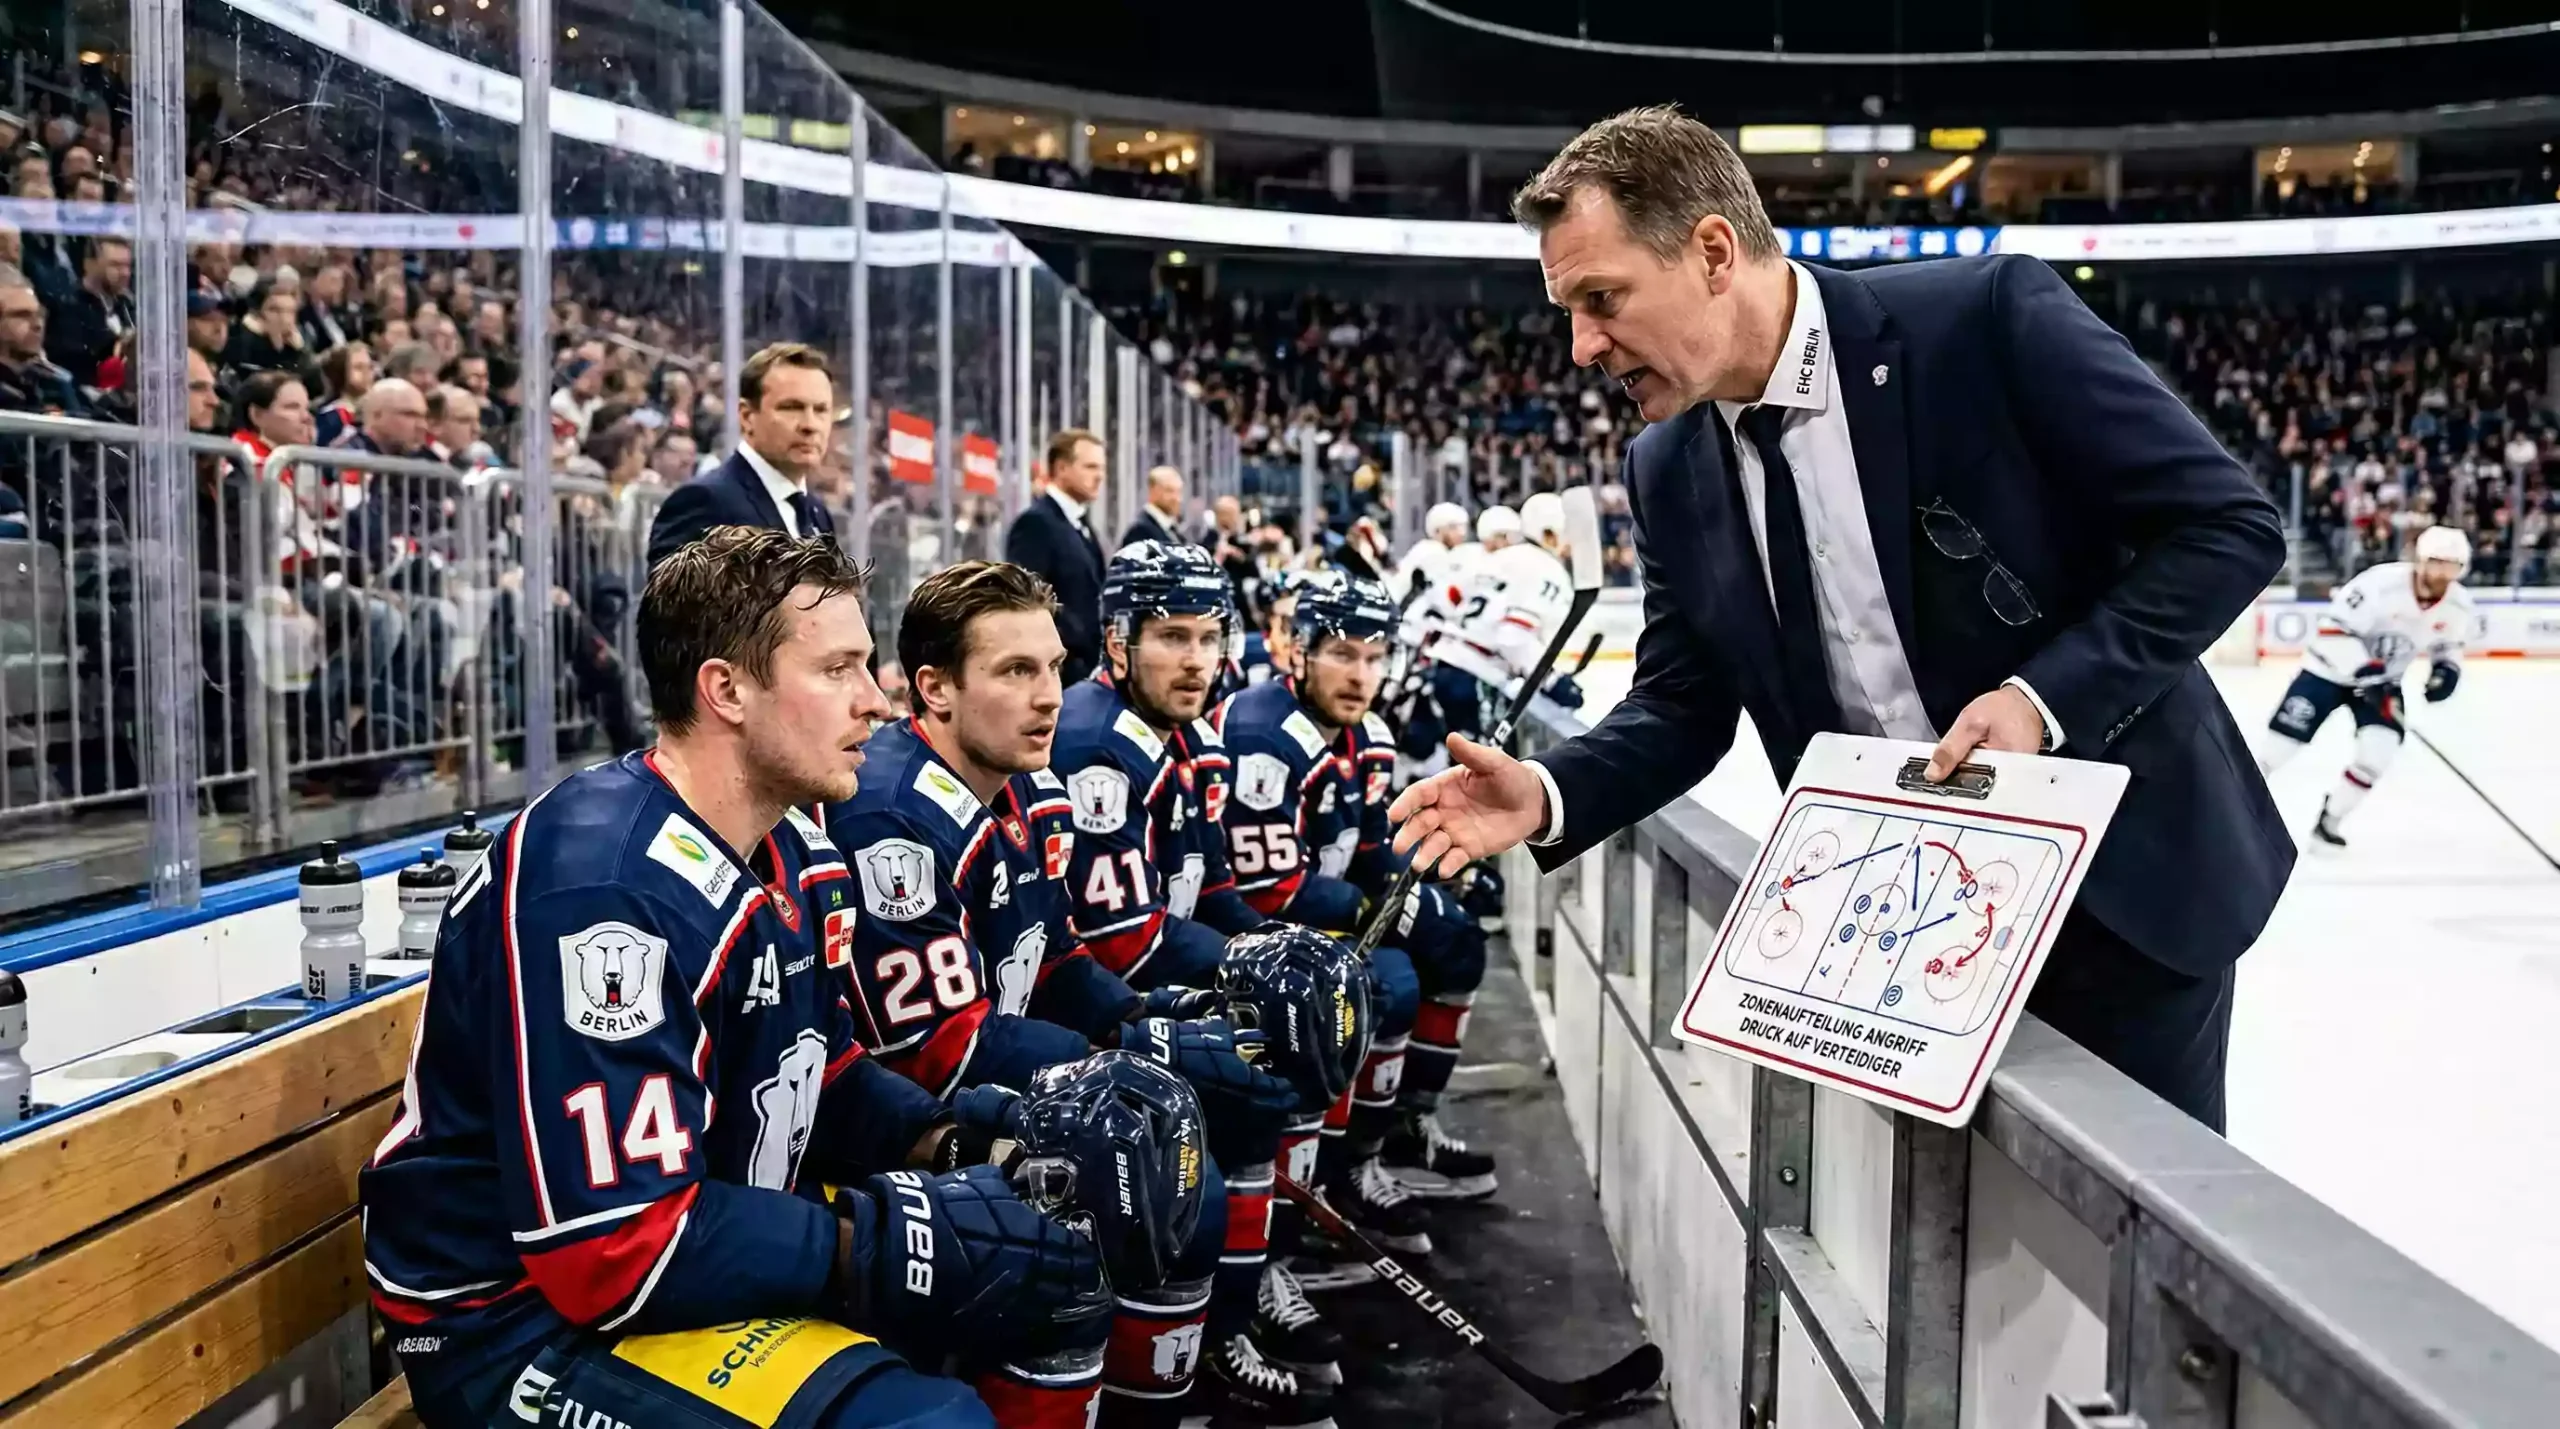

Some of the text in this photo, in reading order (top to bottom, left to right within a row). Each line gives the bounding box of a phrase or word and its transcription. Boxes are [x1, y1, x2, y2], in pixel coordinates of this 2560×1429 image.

[1796, 327, 1821, 395] EHC BERLIN
[1084, 847, 1150, 912] 41
[1230, 823, 1298, 874] 55
[878, 897, 926, 918] BERLIN
[876, 934, 977, 1025] 28
[579, 1009, 649, 1033] BERLIN
[1738, 992, 1929, 1059] ZONENAUFTEILUNG ANGRIFF
[1739, 1016, 1903, 1079] DRUCK AUF VERTEIDIGER
[563, 1073, 694, 1188] 14
[1115, 1151, 1133, 1217] BAUER
[1372, 1256, 1485, 1346] BAUER
